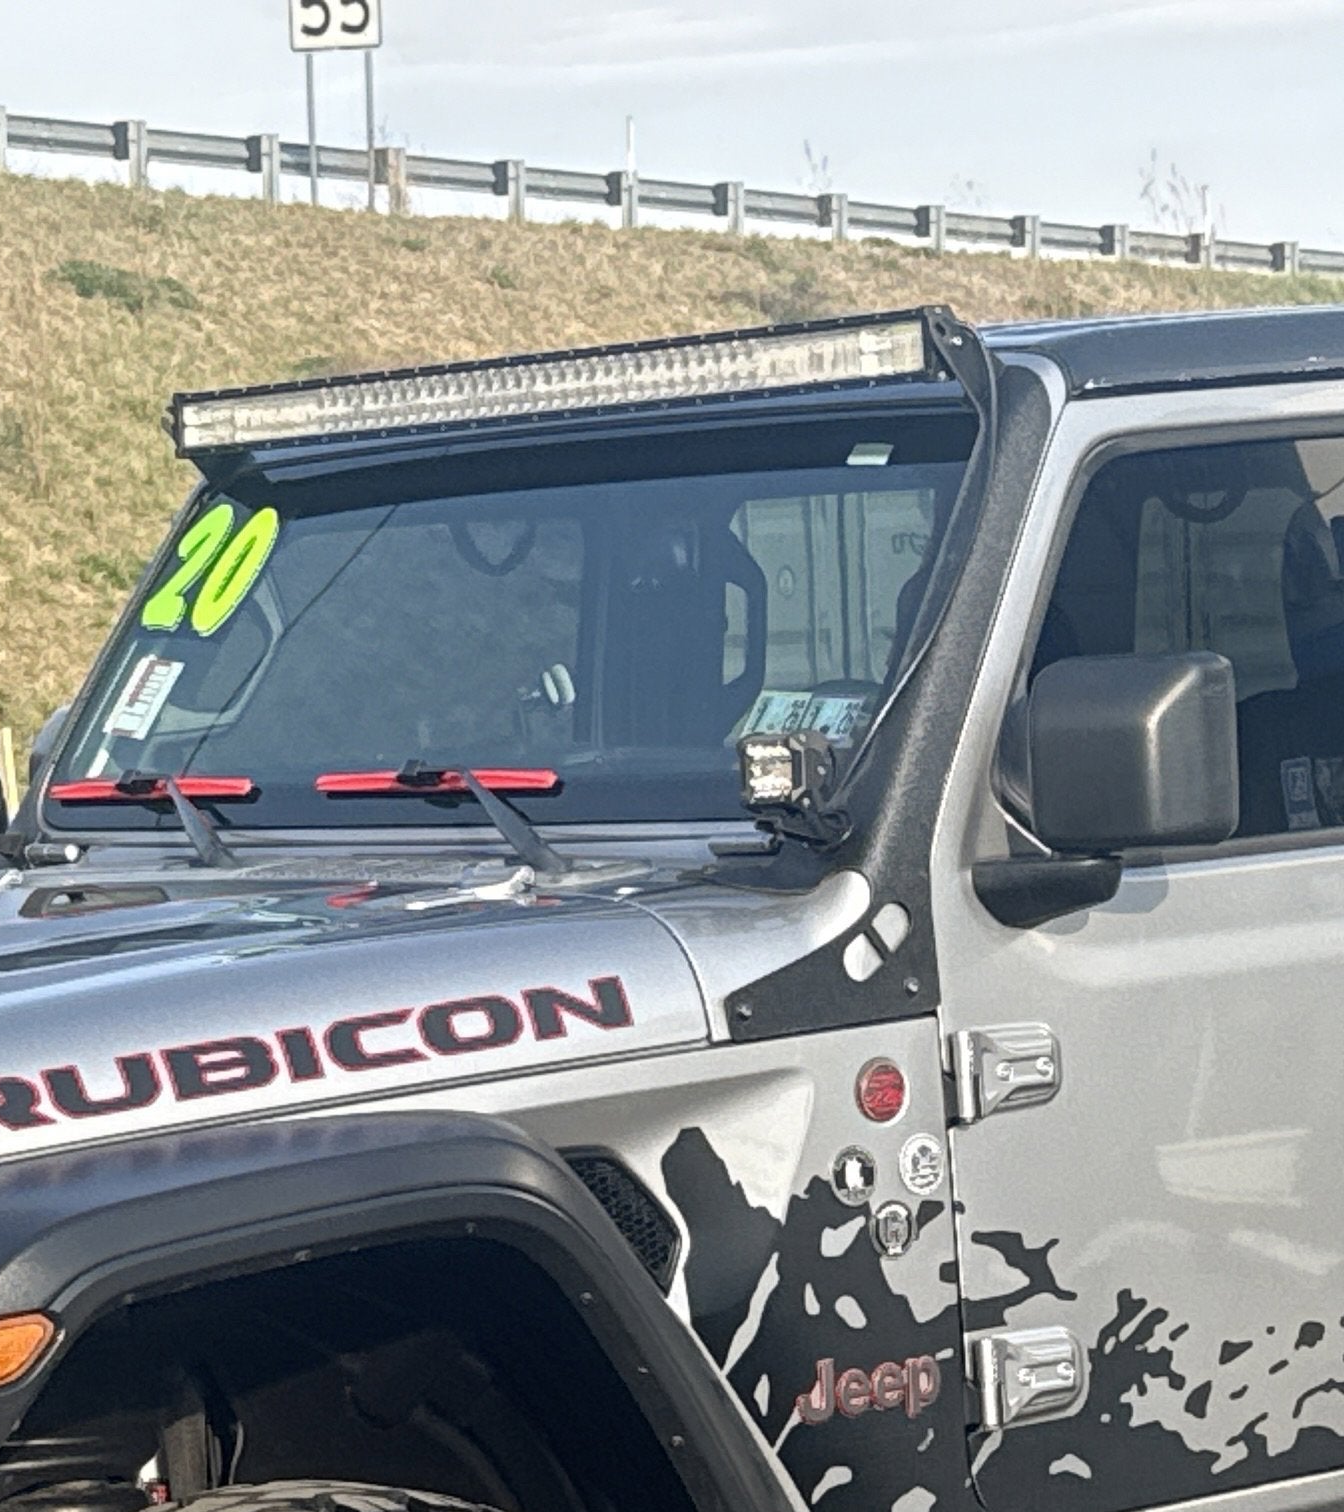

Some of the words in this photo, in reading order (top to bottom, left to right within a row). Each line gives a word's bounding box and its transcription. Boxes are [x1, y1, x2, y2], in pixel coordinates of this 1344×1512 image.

[300, 0, 370, 37] 55
[141, 503, 280, 637] 20
[795, 1354, 941, 1425] Jeep
